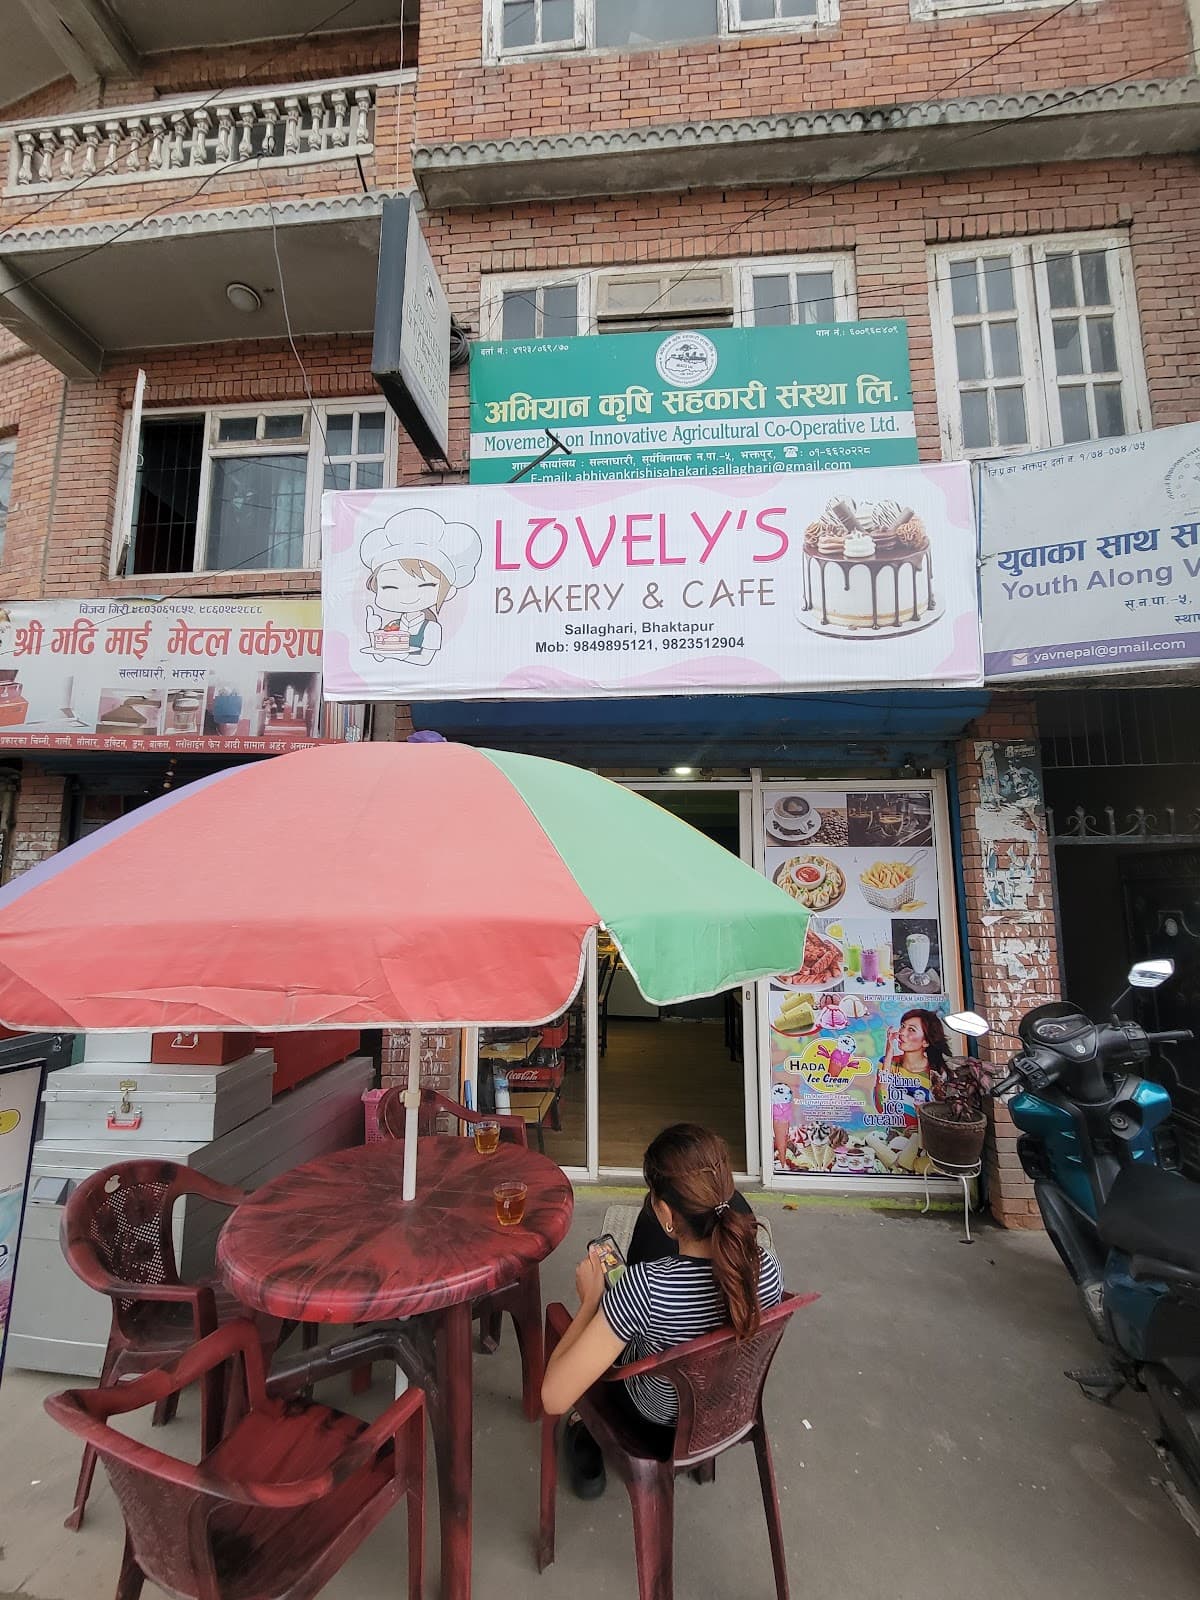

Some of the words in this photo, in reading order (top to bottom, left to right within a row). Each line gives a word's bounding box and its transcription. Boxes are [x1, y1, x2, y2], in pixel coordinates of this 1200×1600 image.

[484, 392, 591, 424] अभियान
[599, 385, 654, 423] कृषि
[661, 380, 768, 414] सहकारी
[775, 380, 848, 409] संस्था
[856, 374, 899, 405] लि.
[565, 434, 585, 447] on
[589, 427, 667, 446] Innovative
[672, 423, 759, 445] Agricultural
[764, 418, 866, 441] Co-Operative
[871, 416, 899, 433] Ltd.
[495, 508, 789, 570] LOVELY'S
[997, 540, 1087, 576] युवाका
[1096, 528, 1160, 559] साथ
[1001, 575, 1078, 601] Youth
[1086, 565, 1173, 591] Along
[495, 582, 625, 614] BAKERY
[642, 582, 664, 609] &
[682, 579, 776, 608] CAFE
[79, 602, 105, 614] विजय
[108, 602, 129, 615] गिरी
[565, 623, 637, 637] Sallaghari,
[642, 621, 715, 635] Bhaktapur
[13, 619, 45, 657] श्री
[104, 619, 152, 661] माई
[167, 618, 233, 658] मेटल
[238, 620, 323, 659] वर्कशप
[535, 641, 569, 653] Mob:
[573, 639, 658, 653] 9849895121,
[662, 637, 745, 650] 9823512904
[1033, 639, 1186, 664] yavnepal@gmail.com
[172, 669, 207, 681] भक्तपुर
[790, 1060, 826, 1071] HADA
[807, 1074, 820, 1083] Ice
[823, 1073, 849, 1084] Cream
[888, 1084, 908, 1101] for
[883, 1100, 905, 1115] ice
[863, 1114, 906, 1127] cream
